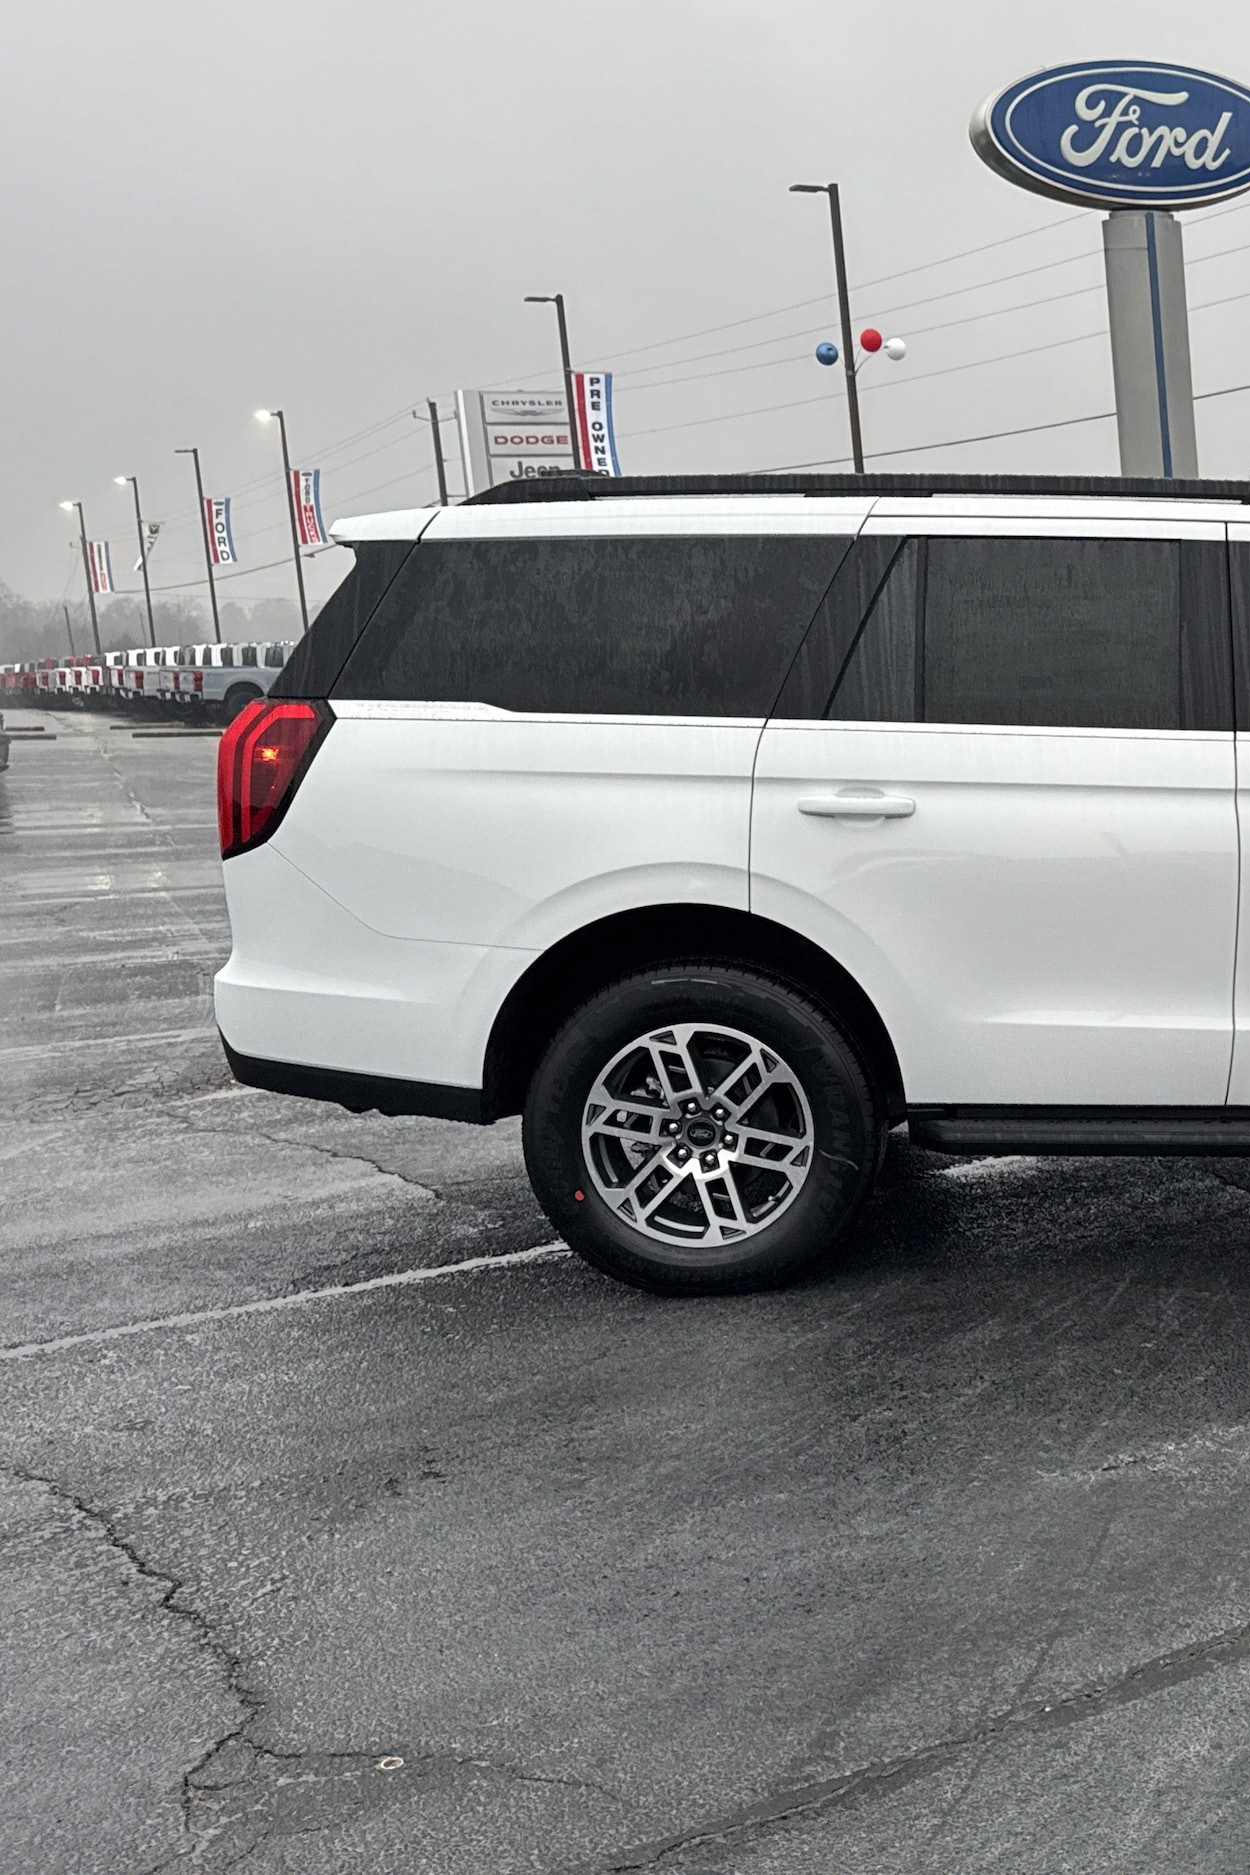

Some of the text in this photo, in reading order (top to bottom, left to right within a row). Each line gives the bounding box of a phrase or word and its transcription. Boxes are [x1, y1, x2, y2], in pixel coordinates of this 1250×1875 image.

[1061, 83, 1233, 171] Ford
[589, 377, 601, 411] PRE
[493, 435, 569, 446] DODGE
[215, 508, 230, 561] FORD
